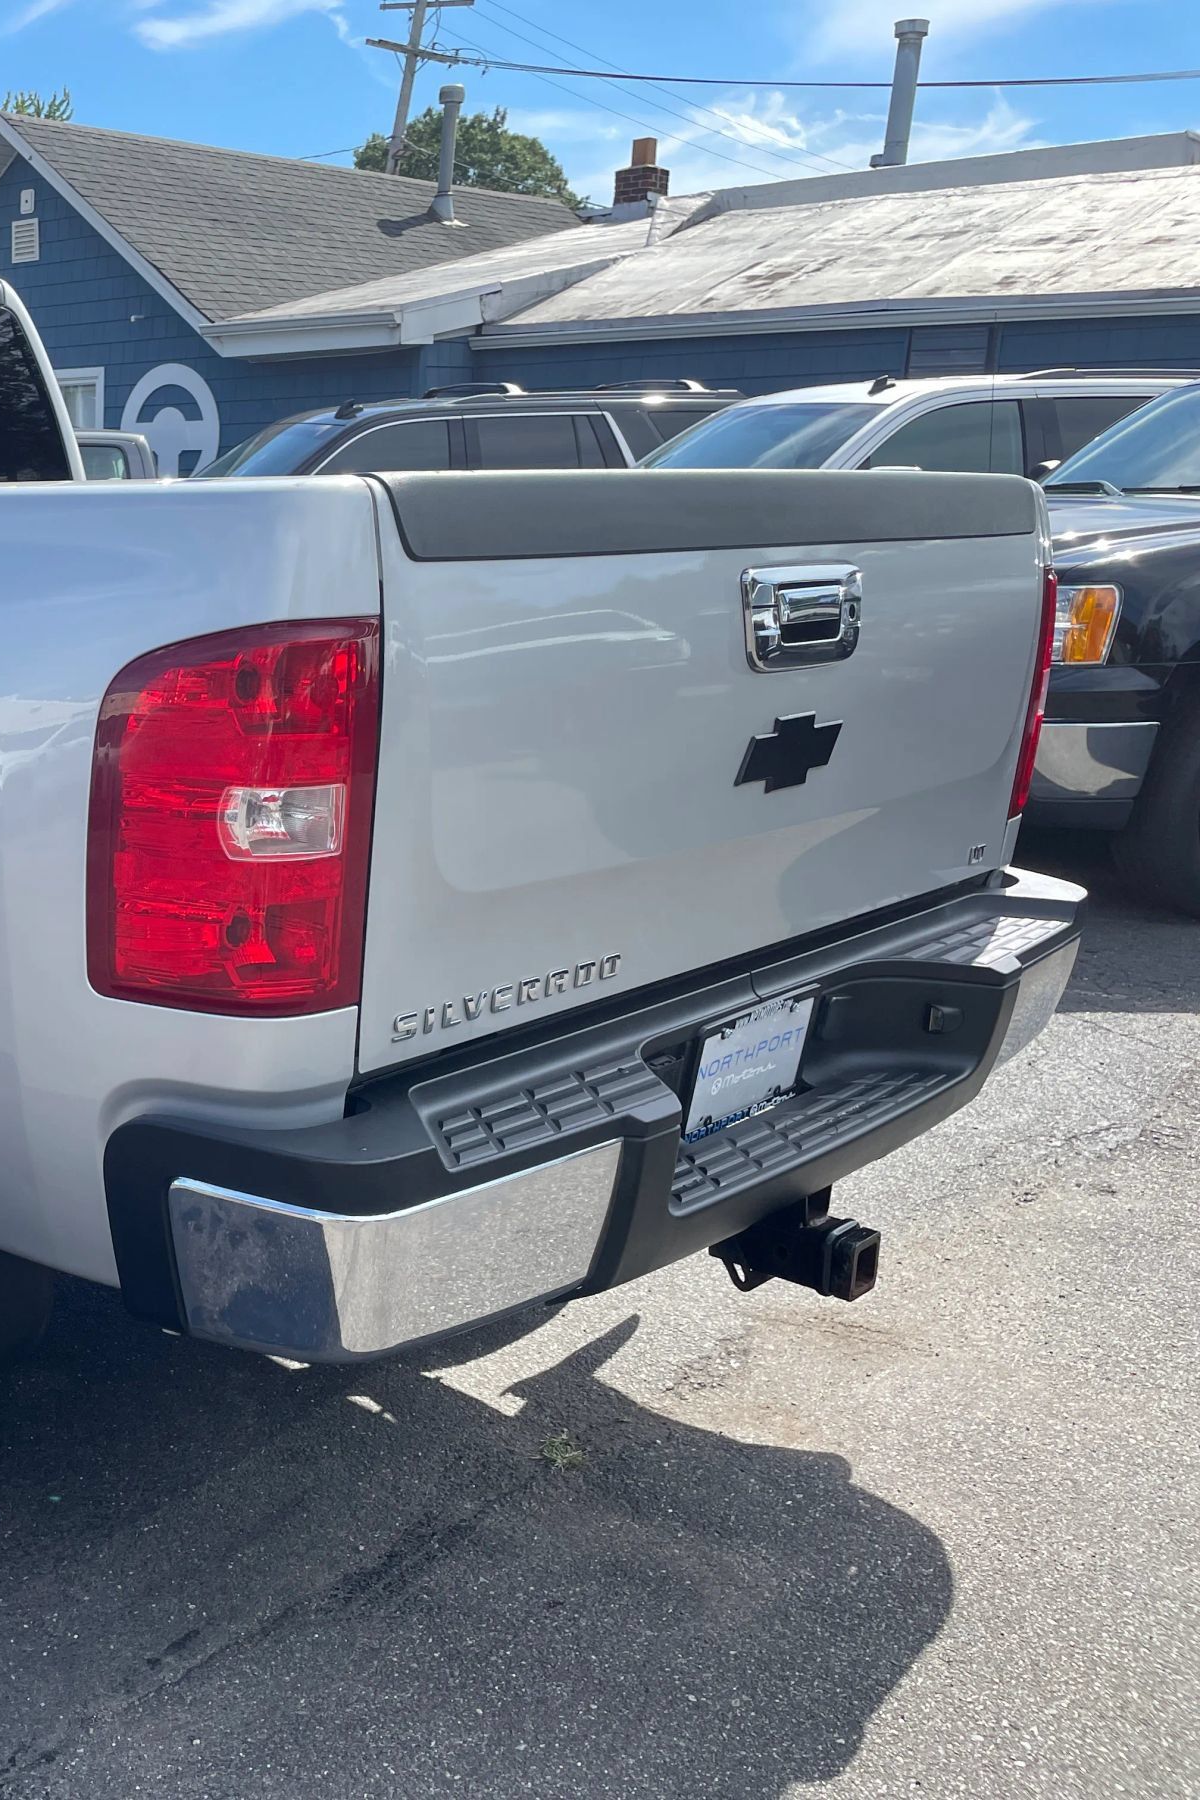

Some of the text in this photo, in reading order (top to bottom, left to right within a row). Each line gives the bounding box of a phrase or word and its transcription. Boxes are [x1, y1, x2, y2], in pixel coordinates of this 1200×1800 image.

[392, 952, 622, 1043] SILVERADO
[699, 1027, 804, 1079] NORTHPORT
[684, 1108, 751, 1145] NORTHPORT
